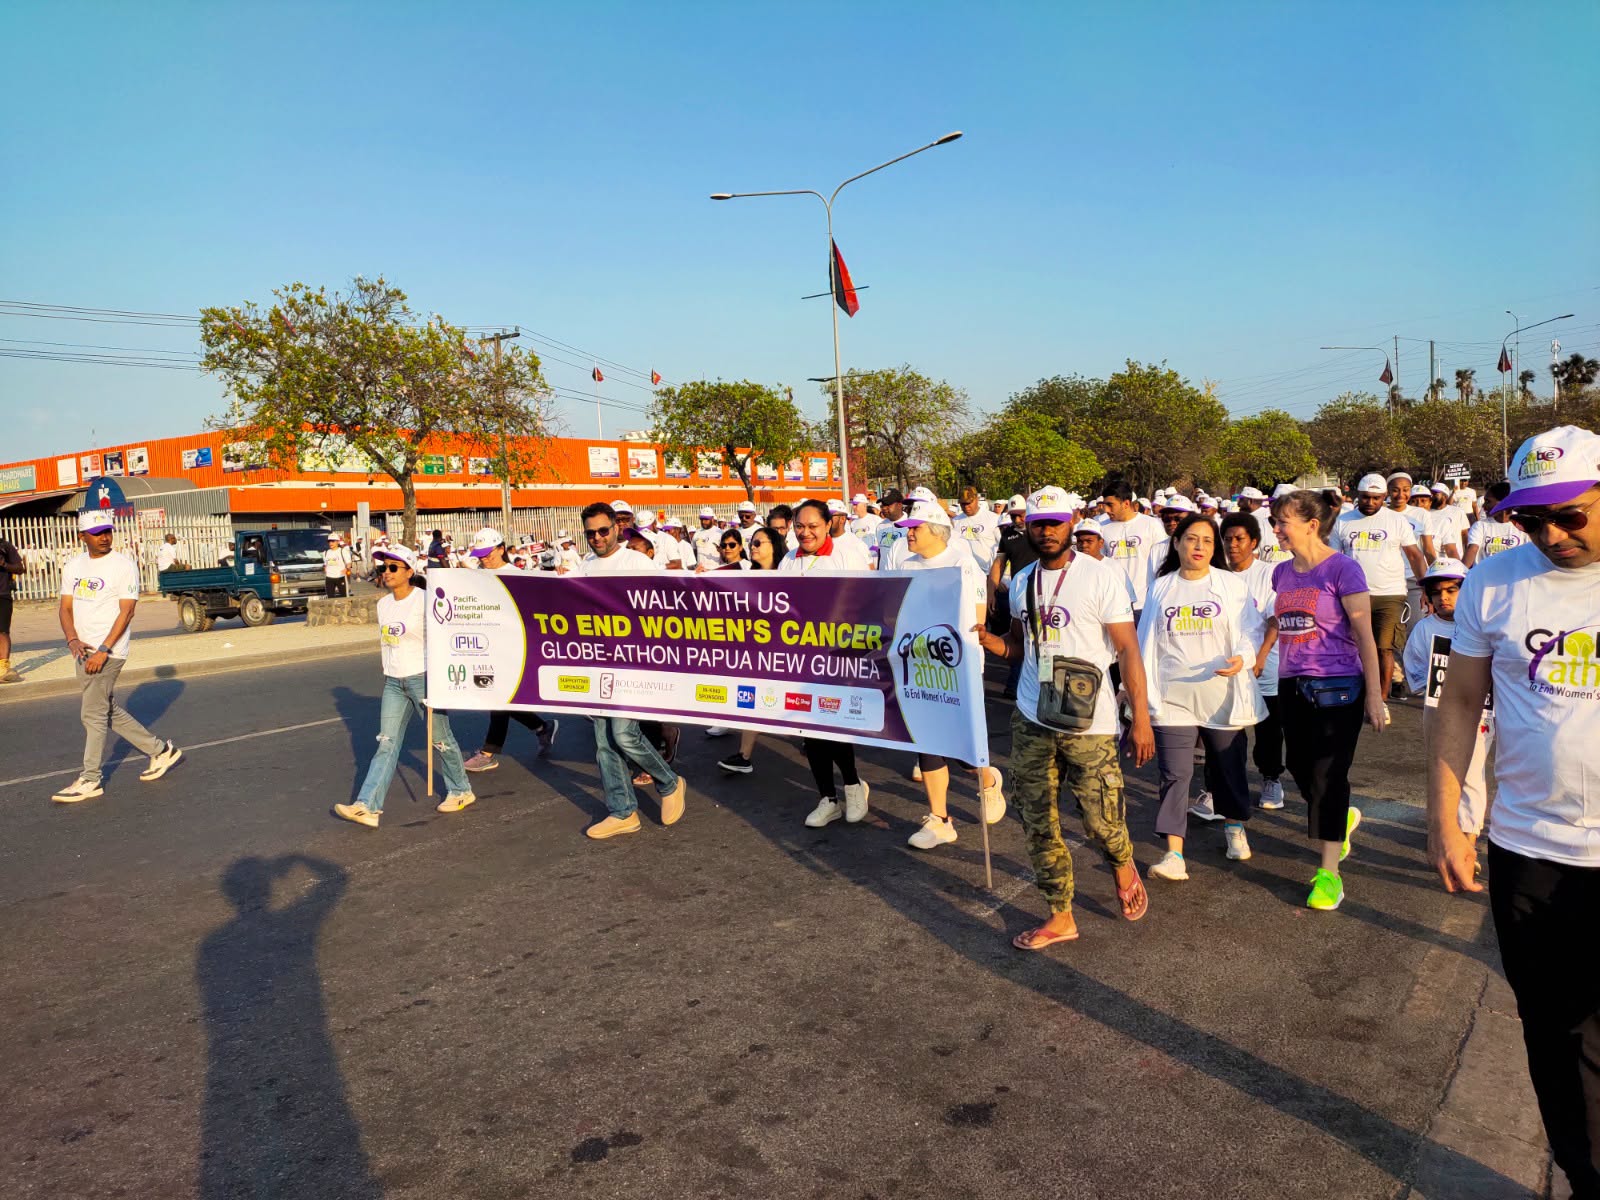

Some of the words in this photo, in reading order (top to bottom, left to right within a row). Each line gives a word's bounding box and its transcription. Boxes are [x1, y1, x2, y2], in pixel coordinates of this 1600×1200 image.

[453, 595, 478, 603] Pacific
[627, 589, 688, 610] WALK
[692, 591, 750, 612] WITH
[758, 591, 790, 614] US
[453, 613, 483, 621] Hospital
[1164, 604, 1215, 619] Globe
[1174, 616, 1213, 631] athon
[1278, 615, 1315, 630] Hires
[533, 613, 569, 635] TO
[575, 614, 632, 637] END
[638, 615, 772, 644] WOMEN'S
[780, 620, 883, 650] CANCER
[1525, 628, 1600, 657] Glo
[541, 641, 681, 666] GLOBE-ATHON
[686, 647, 753, 671] PAPUA
[758, 651, 806, 674] NEW
[811, 654, 880, 680] GUINEA
[913, 661, 959, 692] athon
[1548, 656, 1600, 688] ath
[615, 679, 676, 692] BOUGAINVILLE
[1529, 681, 1538, 693] To
[1538, 682, 1554, 694] End
[698, 693, 725, 701] SPONSORS
[737, 690, 751, 699] CPL
[903, 687, 910, 699] To
[910, 688, 921, 700] End
[921, 689, 943, 703] Women's
